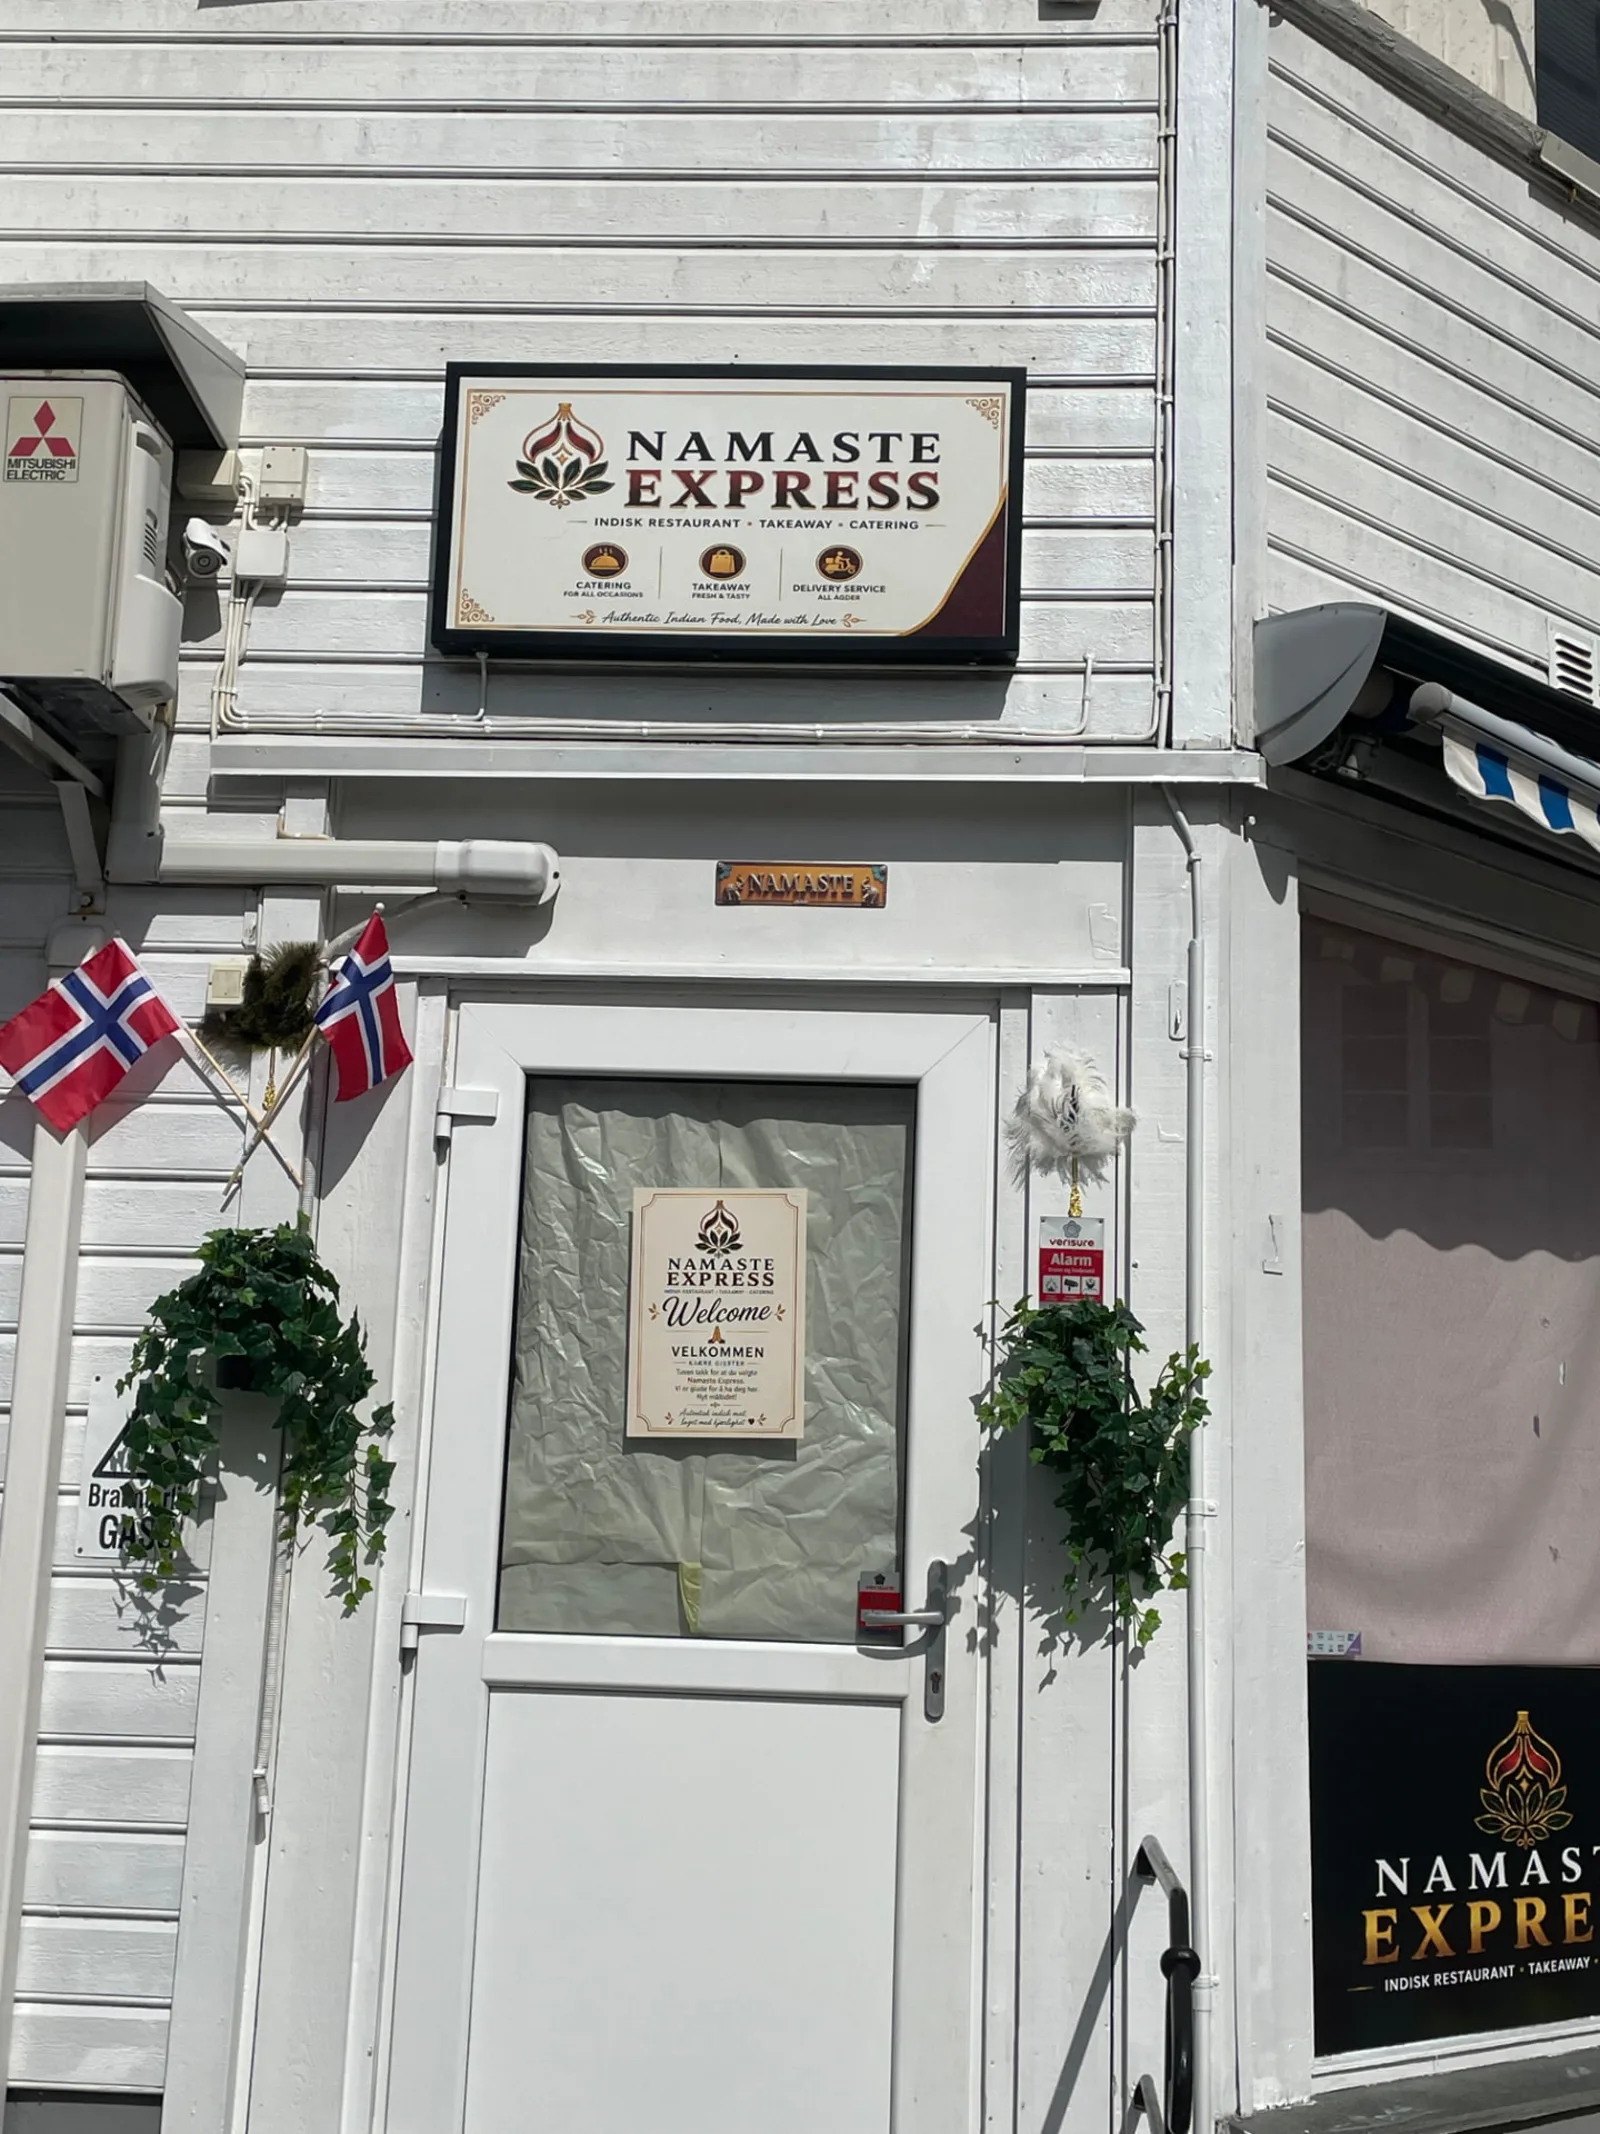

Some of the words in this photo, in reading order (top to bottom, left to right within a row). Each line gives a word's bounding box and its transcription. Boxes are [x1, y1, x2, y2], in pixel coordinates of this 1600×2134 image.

[626, 430, 941, 464] NAMASTE
[7, 458, 76, 470] MITSUBISHI
[7, 469, 66, 480] ELECTRIC
[624, 469, 941, 511] EXPRESS
[594, 517, 643, 528] INDISK
[648, 518, 741, 529] RESTAURANT
[759, 519, 834, 530] TAKEAWAY
[849, 520, 920, 531] CATERING
[576, 581, 632, 590] CATERING
[692, 583, 751, 592] TAKEAWAY
[792, 584, 841, 593] DELIVERY
[843, 585, 886, 593] SERVICE
[602, 610, 660, 624] Authentic
[664, 611, 707, 624] Indian
[710, 612, 741, 625] Food,
[745, 612, 782, 626] Made
[782, 613, 809, 625] with
[811, 614, 838, 626] Love
[749, 872, 854, 894] NAMASTE
[1049, 1238, 1095, 1247] verisure
[667, 1258, 775, 1271] NAMASTE
[1050, 1252, 1093, 1267] Alarm
[666, 1272, 775, 1287] EXPRESS
[662, 1296, 773, 1327] Welcome
[671, 1346, 764, 1358] VELKOMMEN
[1361, 1891, 1595, 1966] EXPRE
[1384, 1974, 1430, 1993] INDISK
[1433, 1964, 1516, 1987] RESTAURANT
[1528, 1955, 1591, 1976] TAKEAWAY
